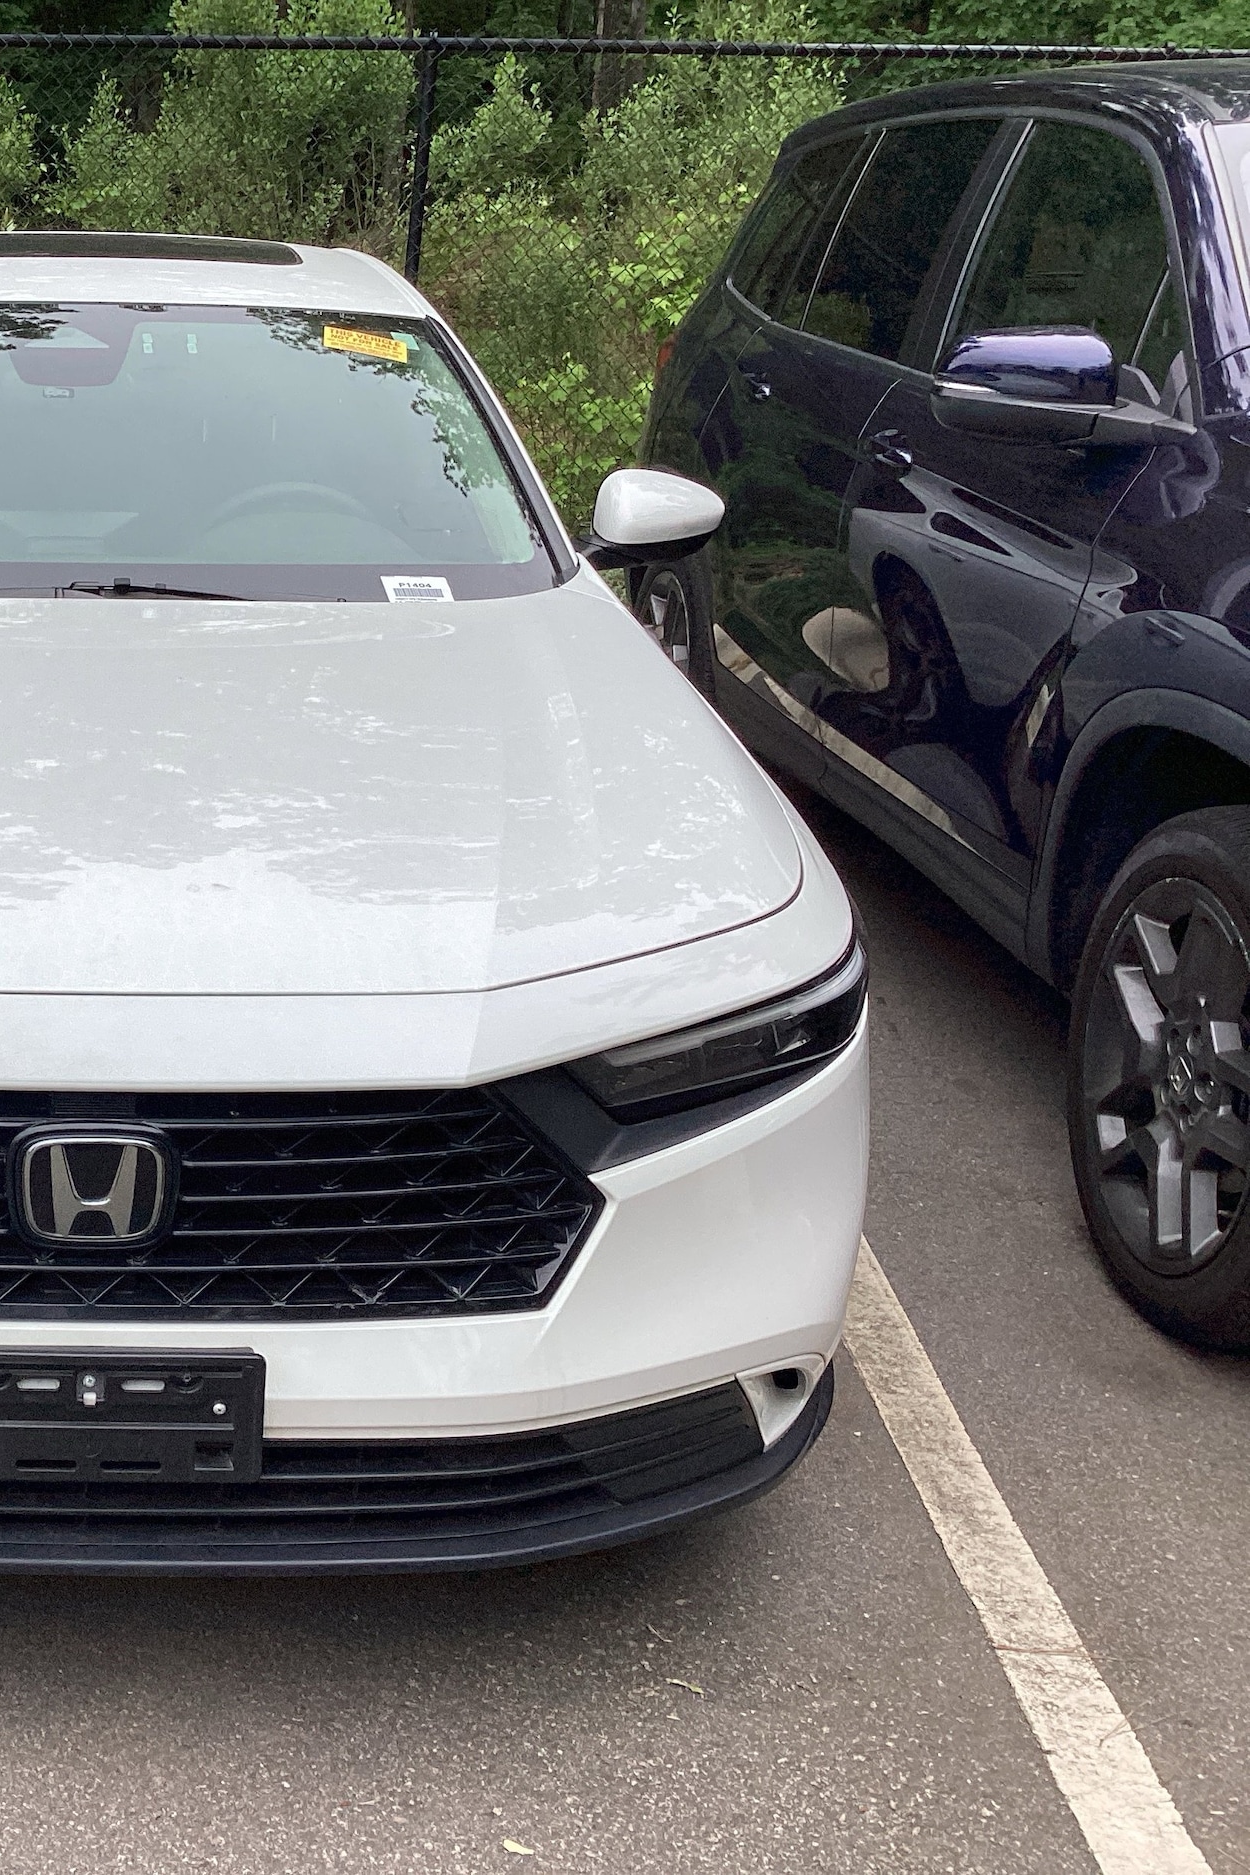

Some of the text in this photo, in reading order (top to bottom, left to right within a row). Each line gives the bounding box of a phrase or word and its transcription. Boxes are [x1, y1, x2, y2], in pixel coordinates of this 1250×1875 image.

[330, 328, 353, 337] THIS
[356, 333, 402, 347] VEHICLE
[330, 333, 349, 342] NOT
[375, 342, 398, 351] SALE
